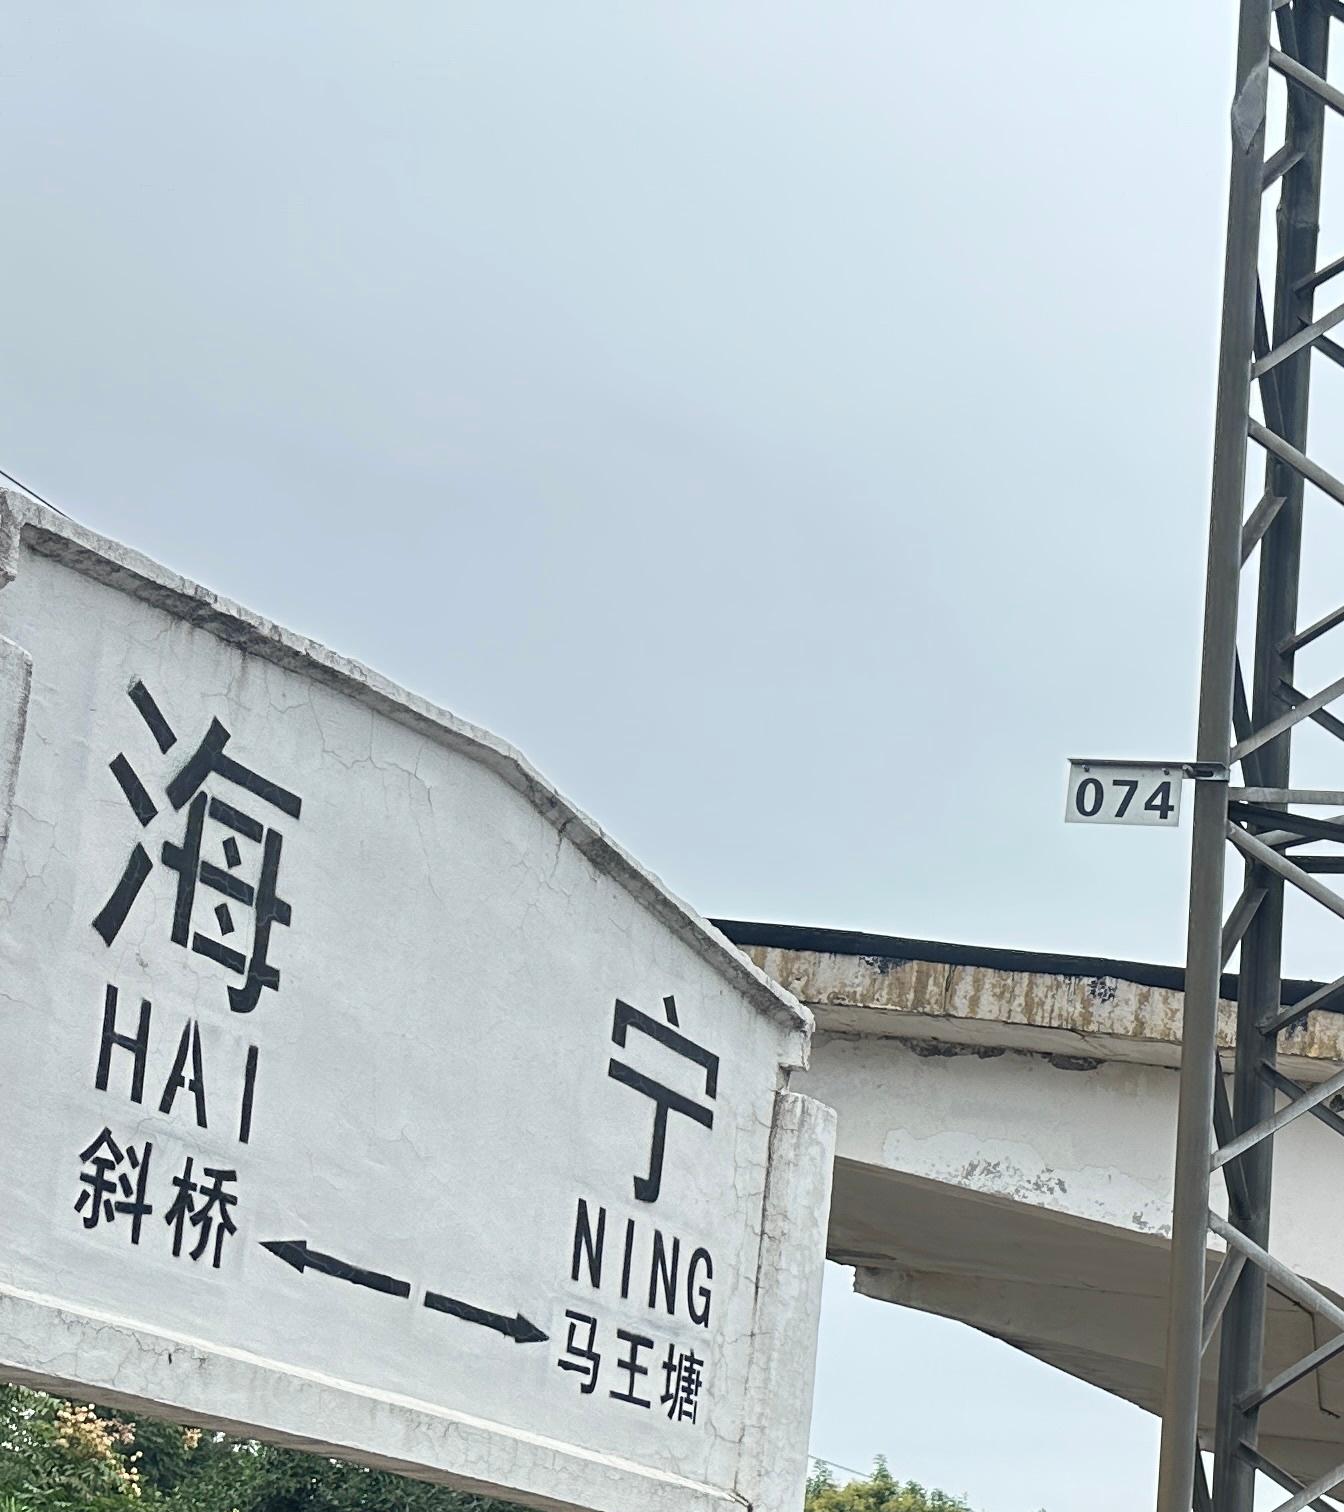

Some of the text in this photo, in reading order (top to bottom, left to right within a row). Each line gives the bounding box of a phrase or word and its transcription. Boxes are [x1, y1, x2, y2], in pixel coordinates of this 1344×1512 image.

[1075, 777, 1175, 820] 074
[74, 1127, 704, 1423] 斜桥 马王塘
[94, 984, 713, 1328] HAI NING
